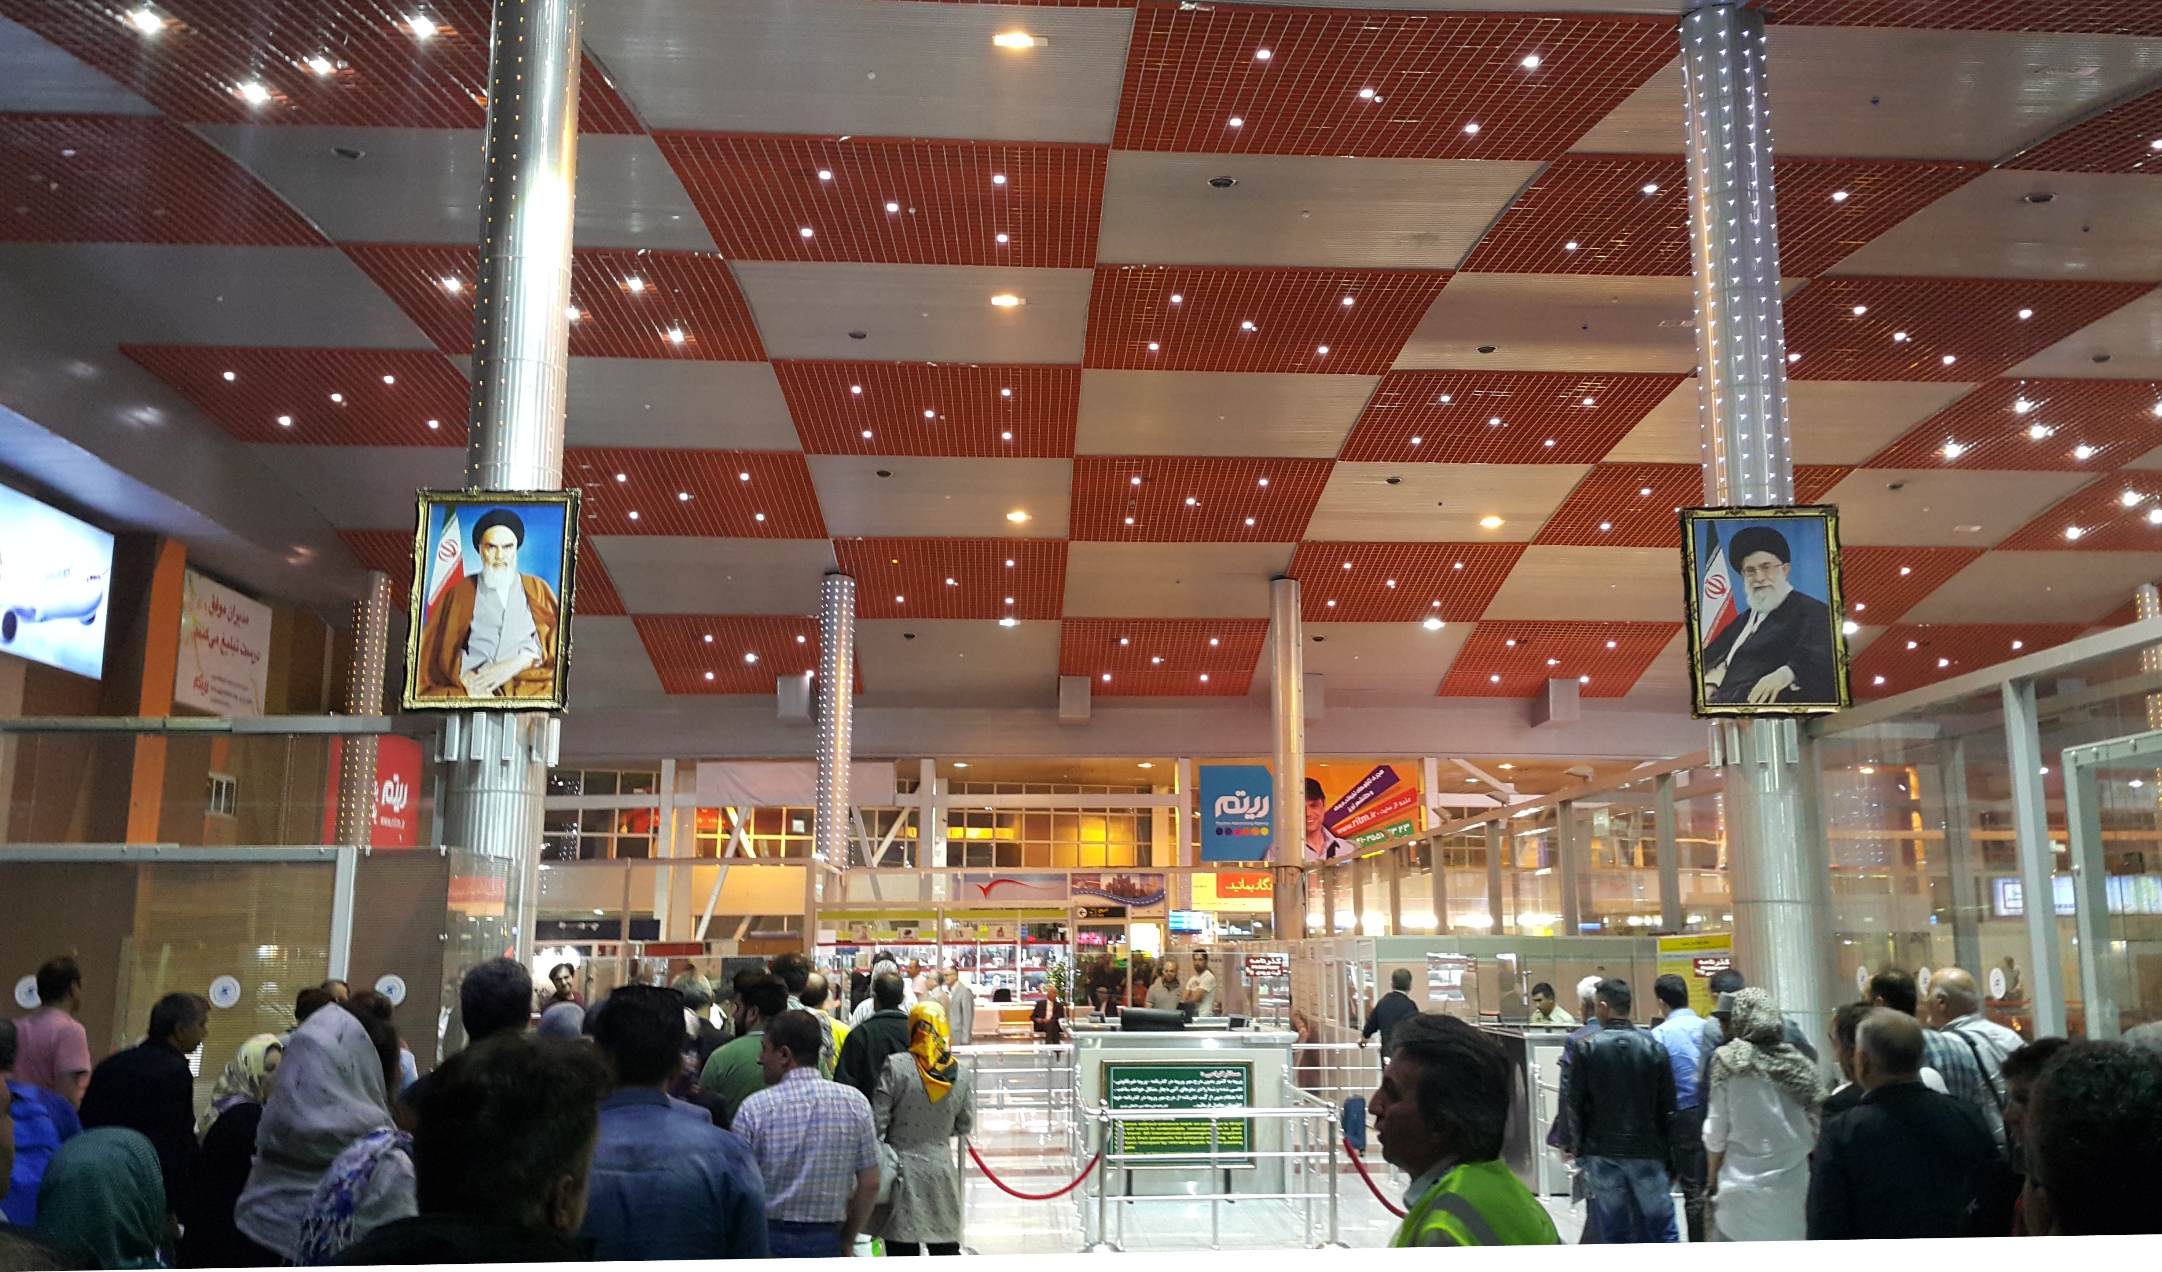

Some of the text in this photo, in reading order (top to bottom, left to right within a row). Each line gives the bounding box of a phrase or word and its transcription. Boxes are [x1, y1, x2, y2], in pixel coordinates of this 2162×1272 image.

[381, 772, 409, 813] ریتم
[1214, 789, 1270, 820] ریتم
[1336, 809, 1378, 834] www.ritm.ir
